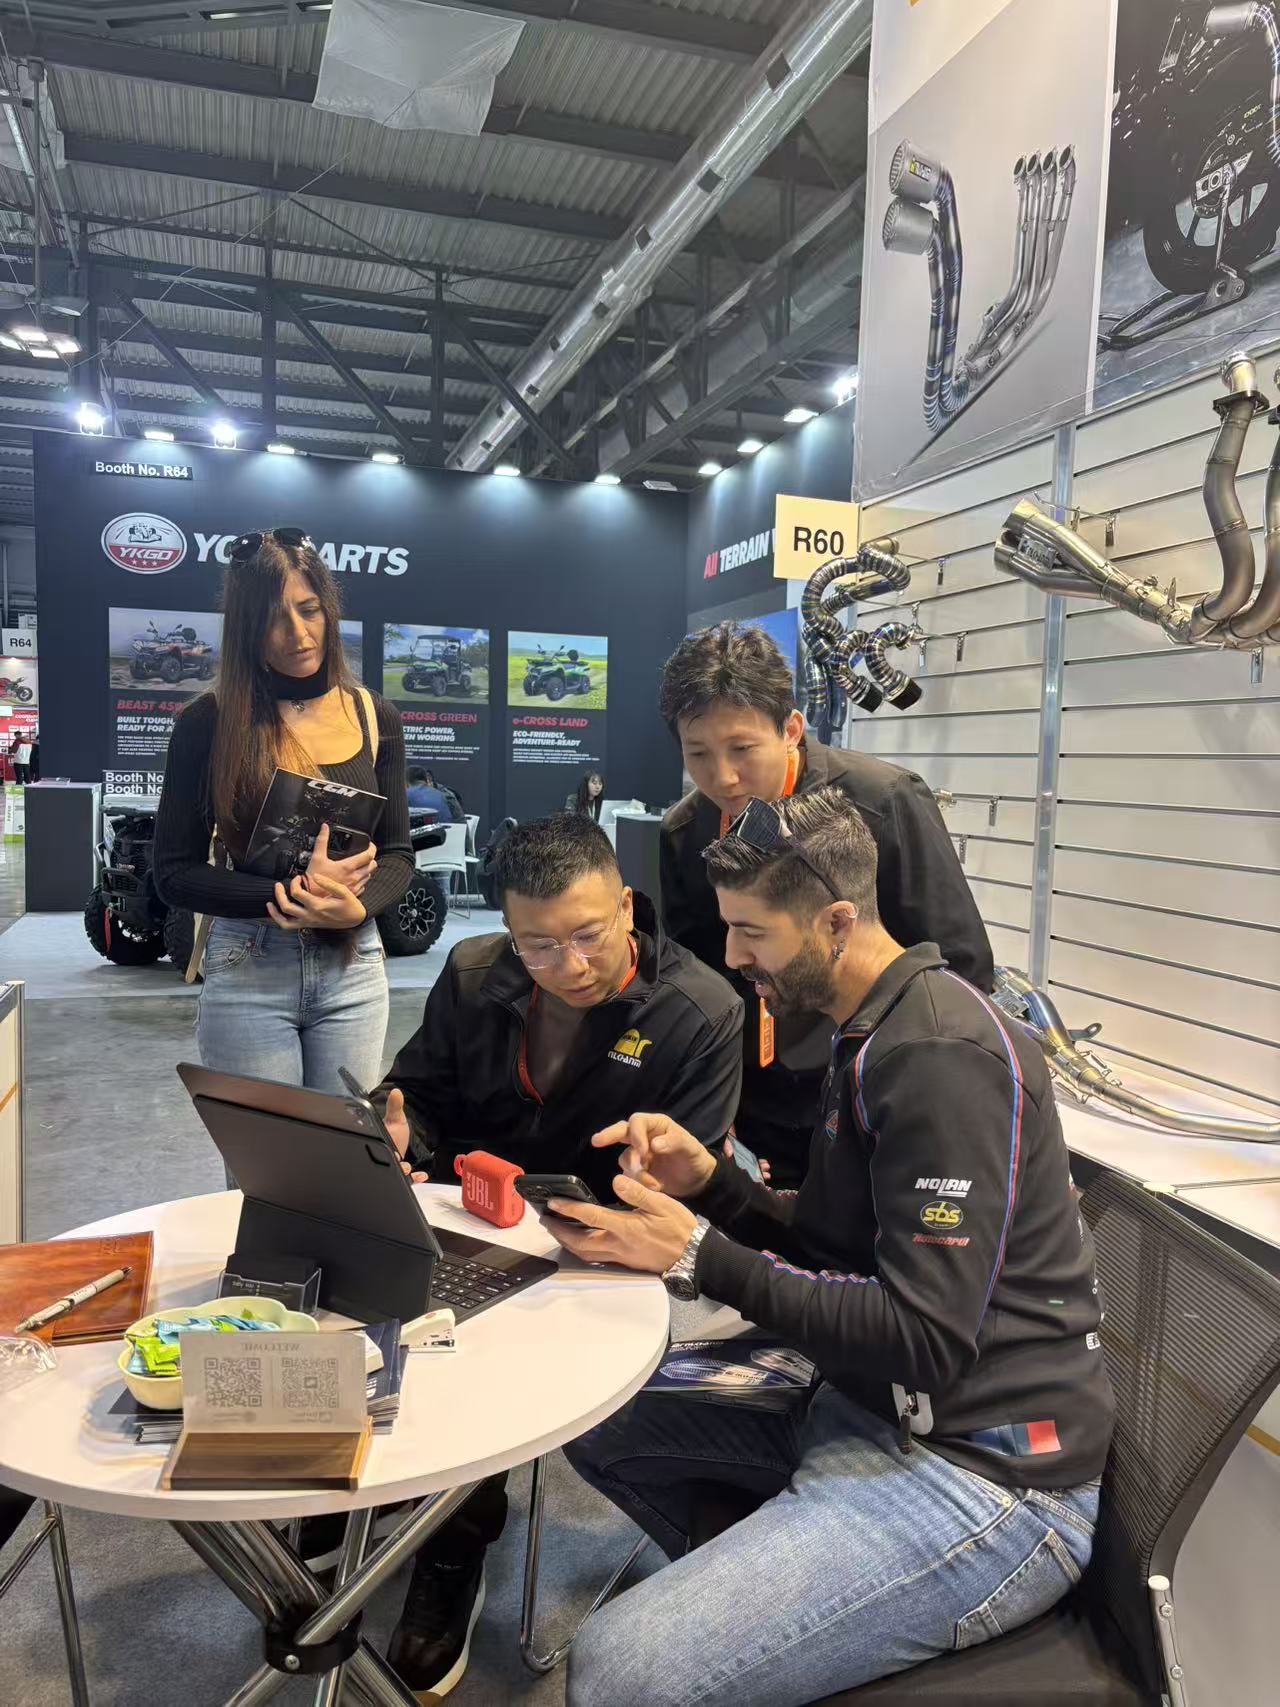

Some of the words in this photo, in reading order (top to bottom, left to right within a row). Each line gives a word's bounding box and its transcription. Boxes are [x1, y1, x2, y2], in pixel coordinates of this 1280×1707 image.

[96, 461, 135, 475] Booth
[138, 463, 161, 476] No.
[163, 465, 189, 478] R64
[793, 526, 845, 556] R60
[119, 547, 174, 561] YKGO
[720, 530, 771, 573] TERRAIN
[304, 540, 410, 576] ARTS
[10, 637, 32, 648] R64
[117, 699, 154, 711] BEAST
[116, 715, 142, 724] BUILT
[400, 710, 438, 722] CROSS
[439, 712, 478, 723] GREEN
[559, 717, 589, 728] LAND
[116, 723, 146, 732] READY
[146, 724, 165, 733] FOR
[424, 726, 456, 736] POWER,
[416, 734, 456, 742] WORKING
[105, 772, 144, 783] Booth
[147, 772, 165, 783] No
[105, 783, 144, 794] Booth
[147, 784, 163, 795] No
[467, 1171, 494, 1211] JBL
[914, 1177, 973, 1196] NOLAN
